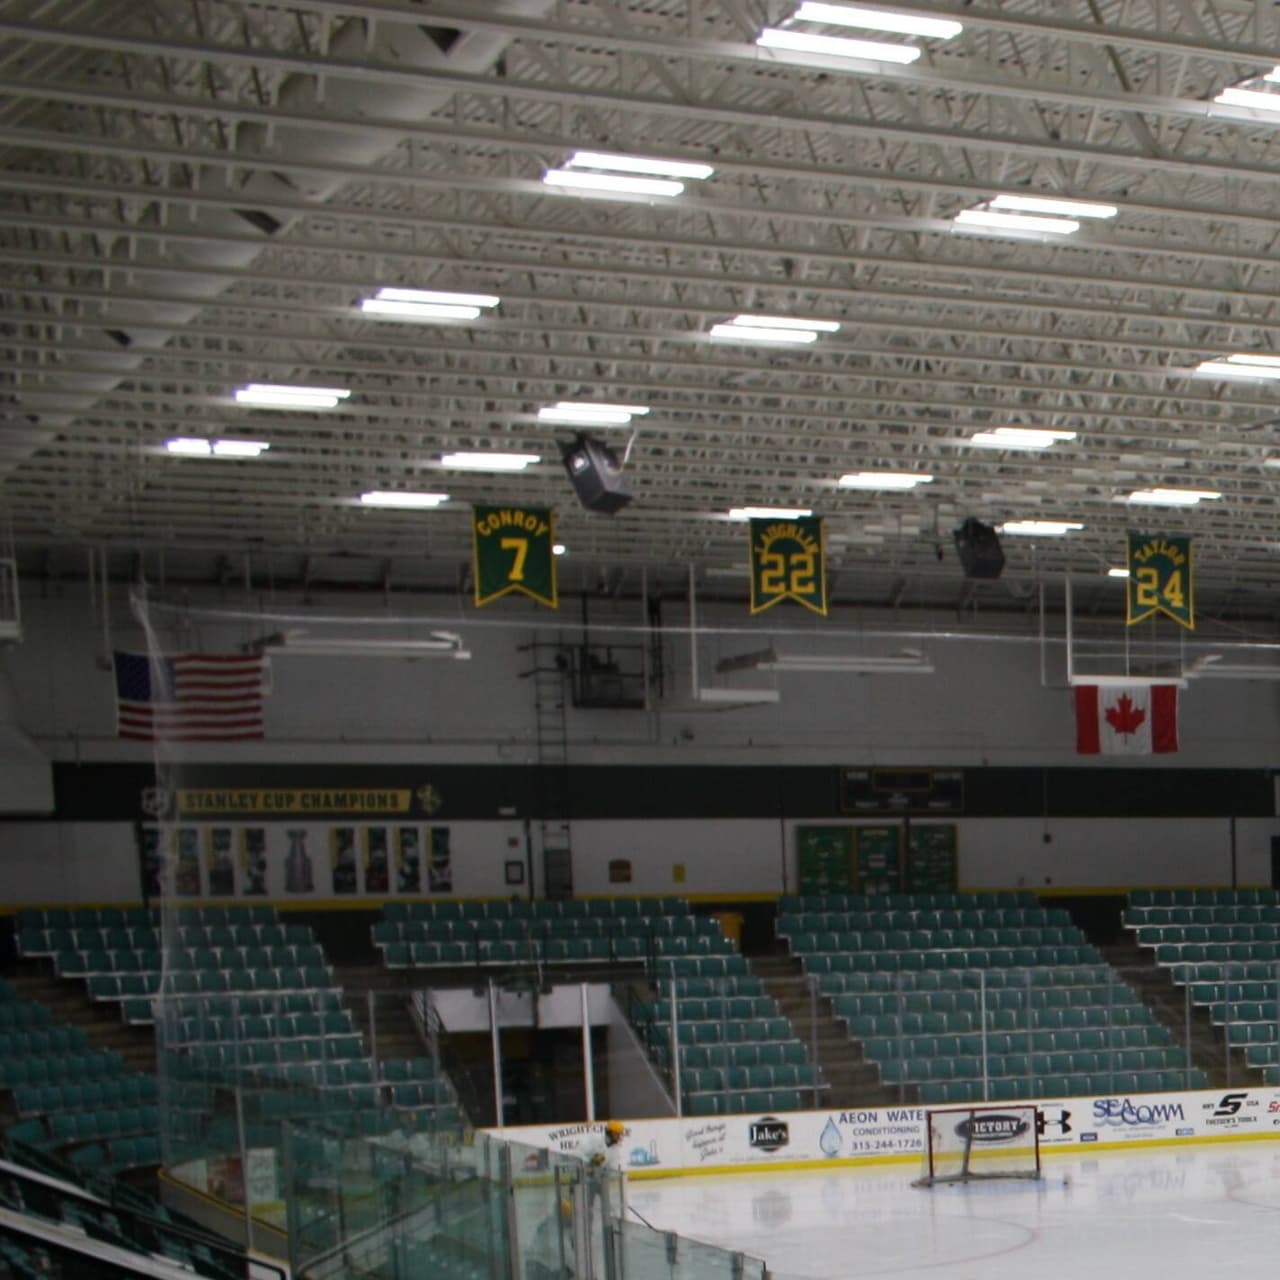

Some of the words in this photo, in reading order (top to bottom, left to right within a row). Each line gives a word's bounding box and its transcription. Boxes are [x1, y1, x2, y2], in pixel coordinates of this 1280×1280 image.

[477, 509, 550, 538] CONROY
[500, 536, 528, 581] 7
[1135, 540, 1185, 567] TAYLOR
[760, 552, 816, 594] 22
[1136, 567, 1184, 608] 24
[186, 792, 258, 810] STANLEY
[263, 793, 295, 810] CUP
[301, 792, 399, 809] CHAMPIONS
[838, 1111, 878, 1126] AEON
[852, 1124, 921, 1138] CONDITIONING
[750, 1124, 788, 1143] Jake's
